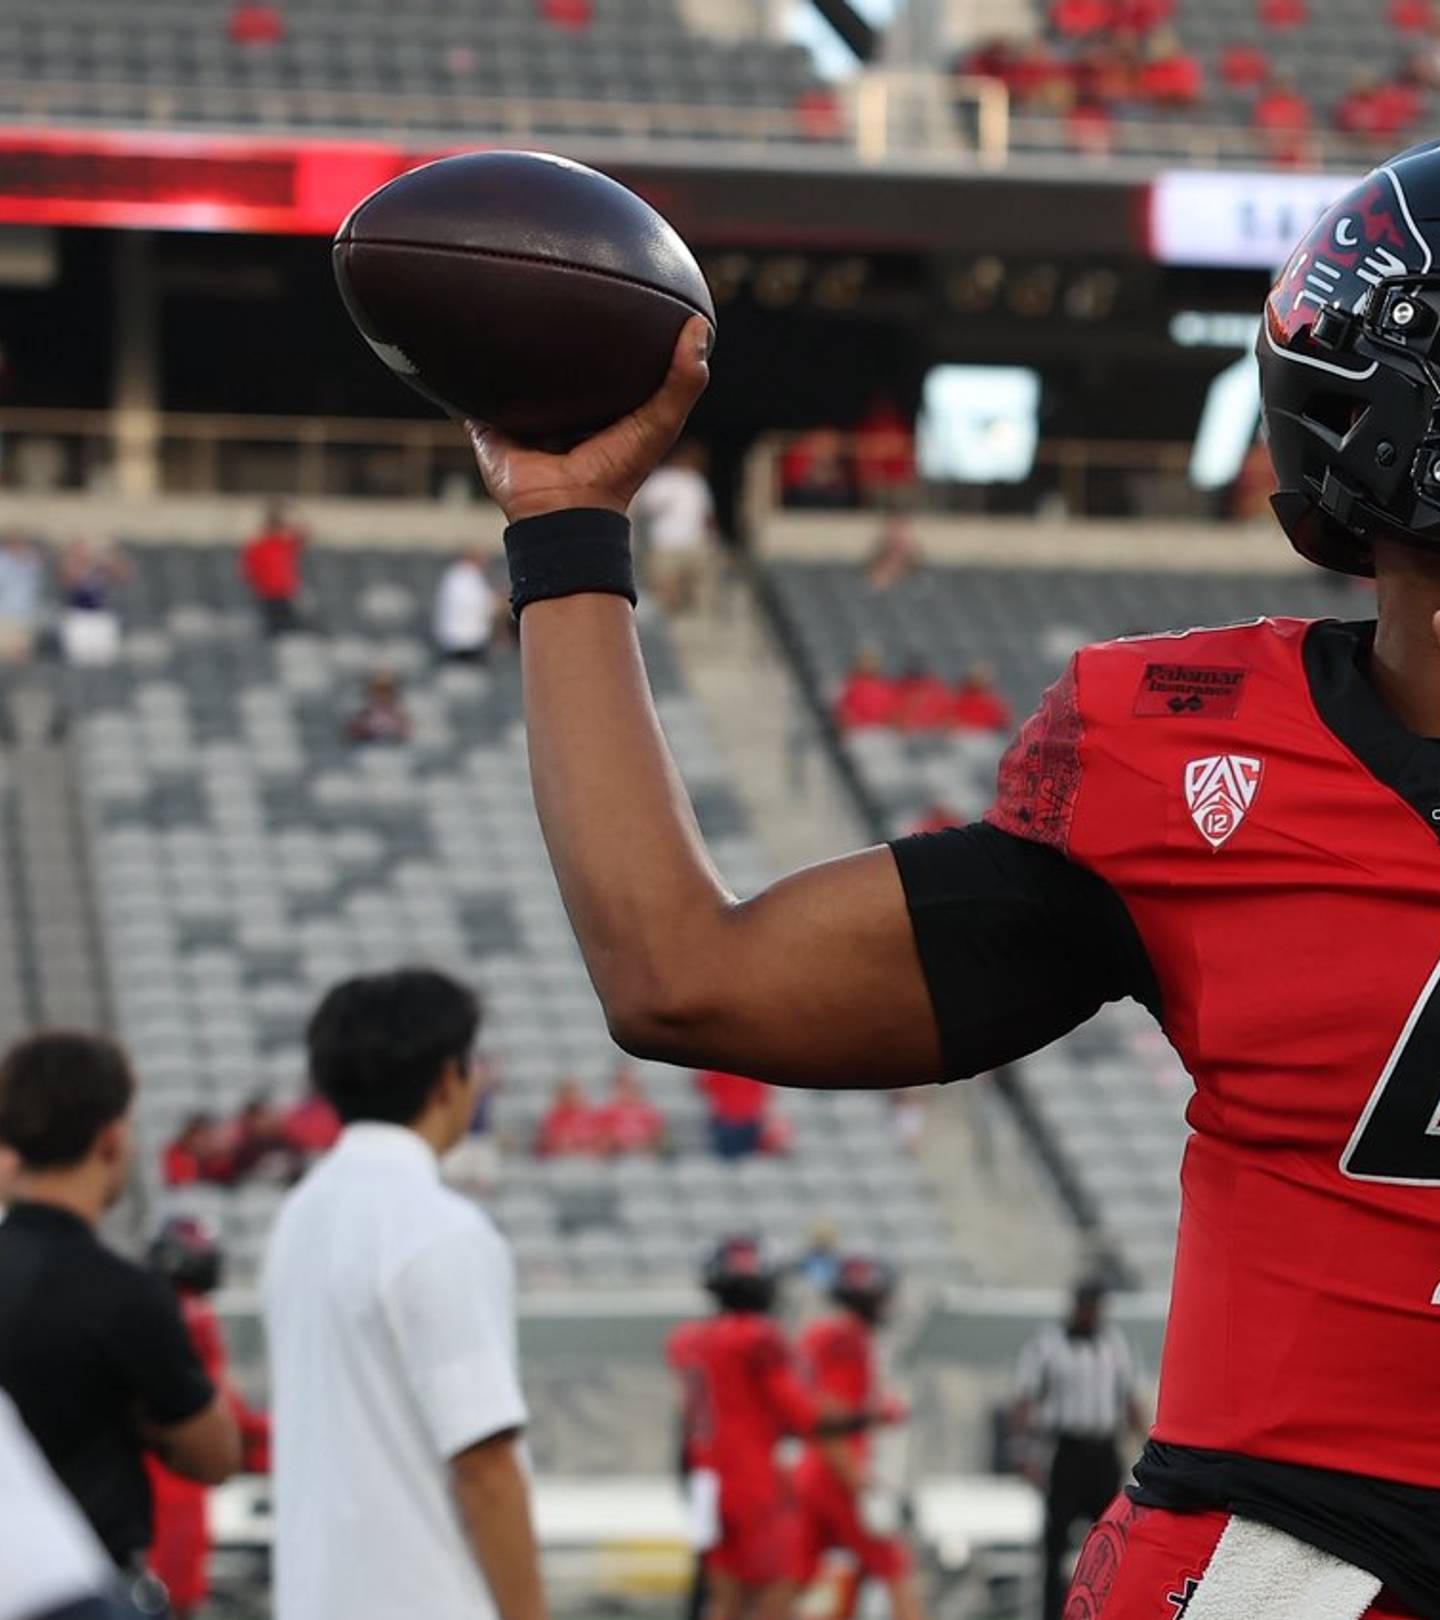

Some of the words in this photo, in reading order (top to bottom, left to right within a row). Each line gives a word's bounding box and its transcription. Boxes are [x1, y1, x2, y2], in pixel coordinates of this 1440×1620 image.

[1146, 663, 1245, 685] Palomar
[1184, 755, 1261, 811] PAC
[1207, 814, 1228, 834] 12
